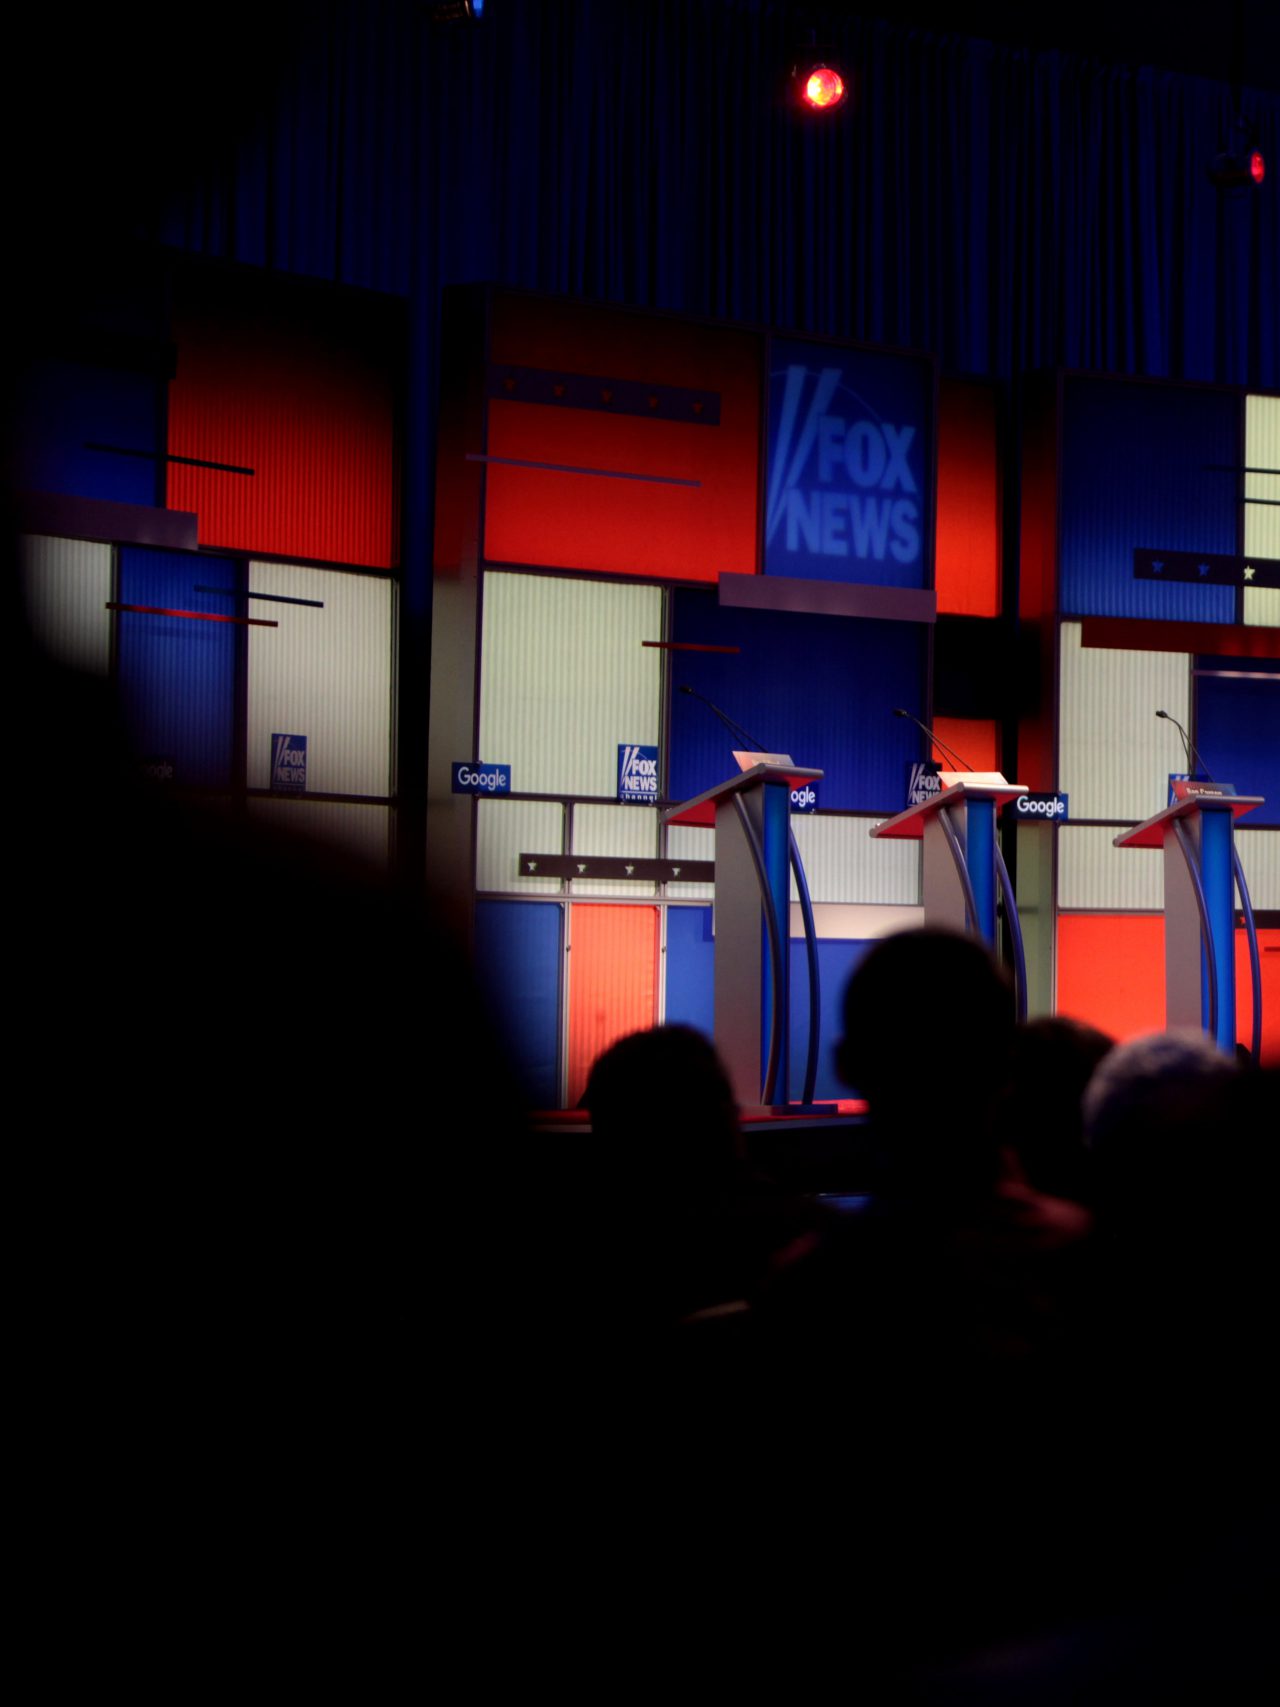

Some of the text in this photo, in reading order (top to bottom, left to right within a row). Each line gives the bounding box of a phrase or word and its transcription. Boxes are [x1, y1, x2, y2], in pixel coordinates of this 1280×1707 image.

[820, 415, 918, 492] FOX
[784, 488, 920, 563] NEWS
[284, 749, 304, 766] FOX
[277, 767, 305, 783] NEWS
[632, 759, 657, 776] FOX
[457, 766, 506, 791] Google
[624, 776, 658, 792] NEWS
[918, 775, 940, 790] FOX
[791, 786, 815, 807] ogle
[912, 791, 940, 804] NEW
[1016, 795, 1064, 817] Google
